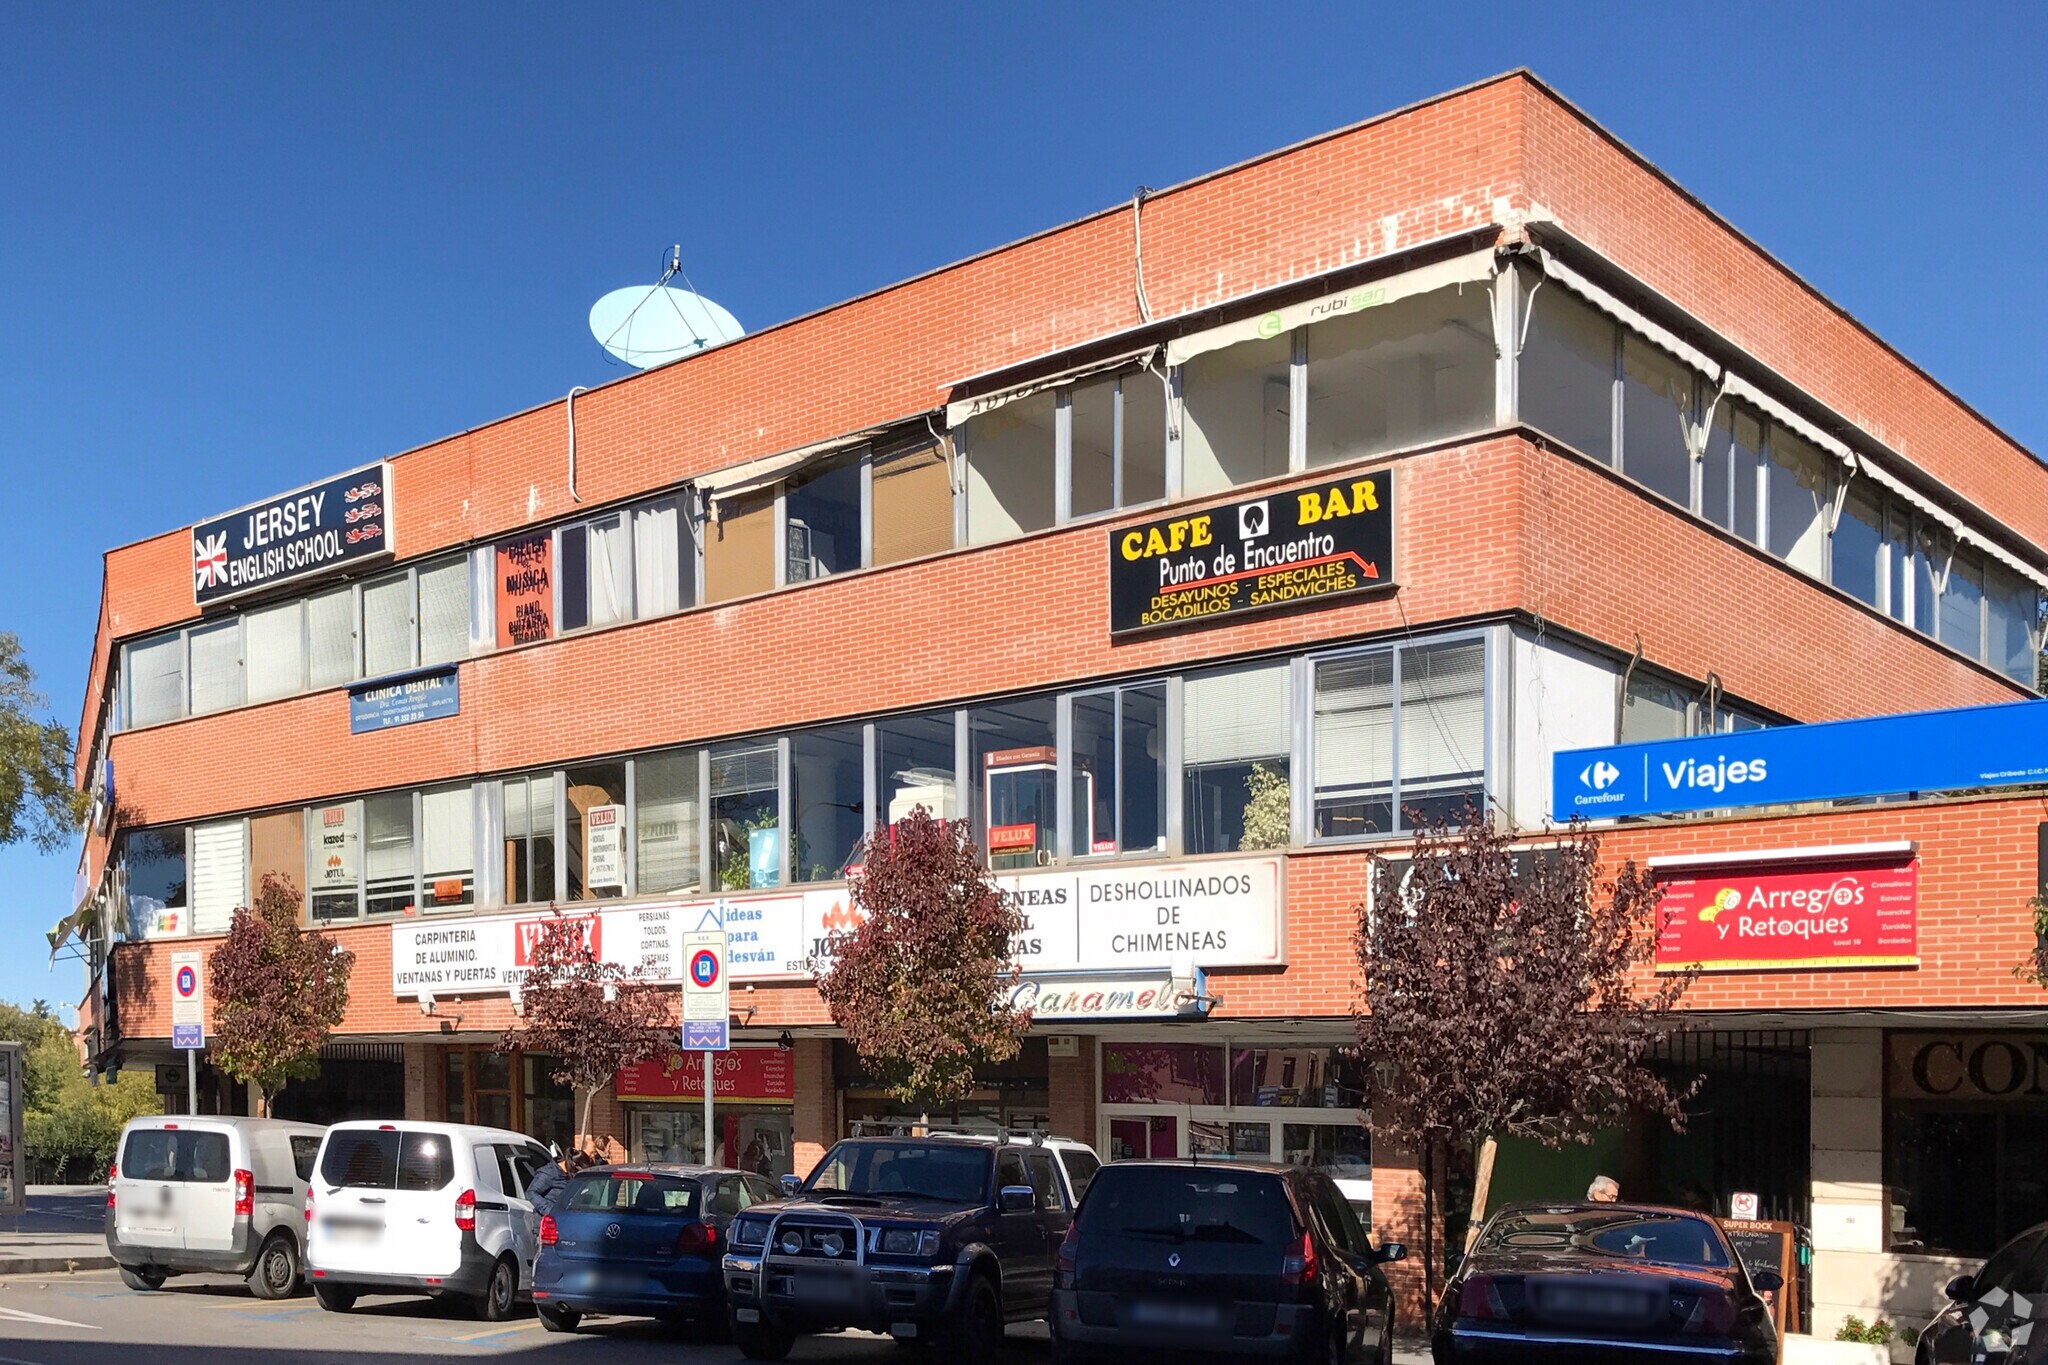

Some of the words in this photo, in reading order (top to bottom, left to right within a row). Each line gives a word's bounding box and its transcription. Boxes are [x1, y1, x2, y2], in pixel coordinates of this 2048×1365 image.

[1297, 480, 1379, 525] BAR
[243, 491, 326, 550] JERSEY
[1121, 515, 1213, 561] CAFE
[229, 546, 285, 587] ENGLISH
[286, 529, 344, 571] SCHOOL
[1160, 553, 1205, 586] Punto
[1213, 544, 1236, 576] de
[1244, 532, 1335, 570] Encuentro
[1151, 582, 1239, 610] DESAYUNOS
[1258, 561, 1345, 590] ESPECIALES
[1141, 597, 1231, 625] BOCADILLOS
[1250, 574, 1356, 605] SANDWICHES
[405, 677, 442, 694] DENTAL
[1662, 755, 1767, 793] Viajes
[1574, 793, 1625, 805] Carrefour
[591, 810, 615, 825] VELUX
[323, 831, 345, 845] kazed
[992, 828, 1031, 843] VELUX
[1093, 843, 1114, 851] VELUX
[1090, 874, 1251, 903] DESHOLLINADOS
[1747, 877, 1865, 915] Arreglos
[638, 911, 670, 922] PERSIANAS
[726, 907, 762, 922] ideas
[1157, 906, 1180, 925] DE
[1717, 923, 1730, 940] y
[1739, 916, 1848, 940] Retoques
[415, 929, 476, 946] CARPINTERIA
[728, 931, 758, 946] para
[1111, 930, 1227, 953] CHIMENEAS
[415, 952, 427, 965] DE
[429, 948, 478, 964] ALUMINIO.
[396, 969, 443, 985] VENTANAS
[444, 970, 452, 981] Y
[454, 967, 497, 982] PUERTAS
[637, 966, 672, 978] LECTRICOS
[671, 1080, 679, 1091] y
[1723, 1220, 1748, 1229] SUPER
[1749, 1222, 1773, 1230] BOCK
